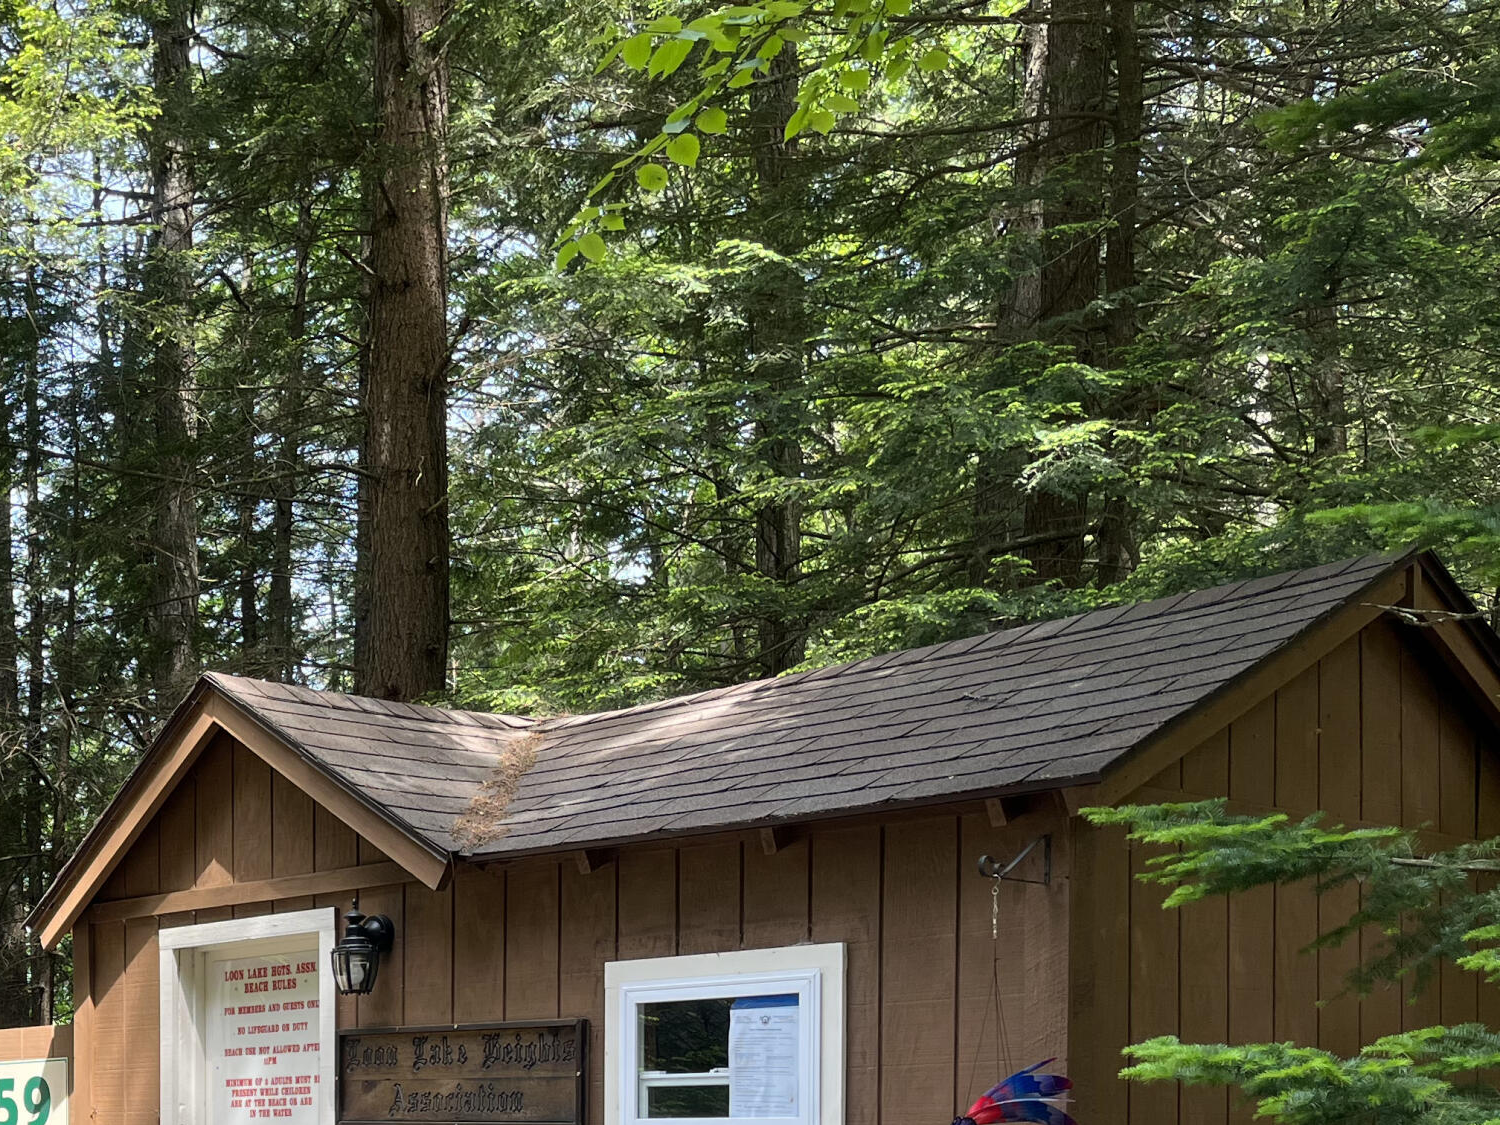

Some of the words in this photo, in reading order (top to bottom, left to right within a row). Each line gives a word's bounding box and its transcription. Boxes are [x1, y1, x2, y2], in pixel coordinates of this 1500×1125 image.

[225, 970, 244, 982] LOON
[248, 967, 268, 979] LAKE
[271, 965, 292, 977] HGTS.
[296, 962, 317, 974] ASSN.
[244, 981, 269, 993] BEACH
[272, 978, 297, 991] RULES
[224, 1007, 235, 1016] FOR
[238, 1005, 266, 1015] MEMBERS
[268, 1003, 280, 1012] AND
[283, 1001, 304, 1010] GUESTS
[307, 1000, 320, 1008] ONL
[237, 1027, 245, 1035] NO
[248, 1024, 279, 1034] LIFEGUARD
[282, 1023, 290, 1031] ON
[293, 1022, 308, 1031] DUTY
[225, 1048, 242, 1057] BEACH
[245, 1047, 256, 1055] USE
[259, 1046, 270, 1055] NOT
[272, 1045, 300, 1054] ALLOWED
[346, 1038, 398, 1073] Loon
[413, 1036, 468, 1072] Lake
[481, 1033, 576, 1070] Heights
[295, 1075, 311, 1084] MUST
[260, 1088, 278, 1096] WHILE
[281, 1086, 311, 1095] CHILDREN
[255, 1099, 265, 1107] THE
[268, 1098, 287, 1106] BEACH
[389, 1083, 524, 1117] Association
[250, 1109, 256, 1118] IN
[259, 1109, 270, 1117] THE
[273, 1108, 292, 1117] WATER
